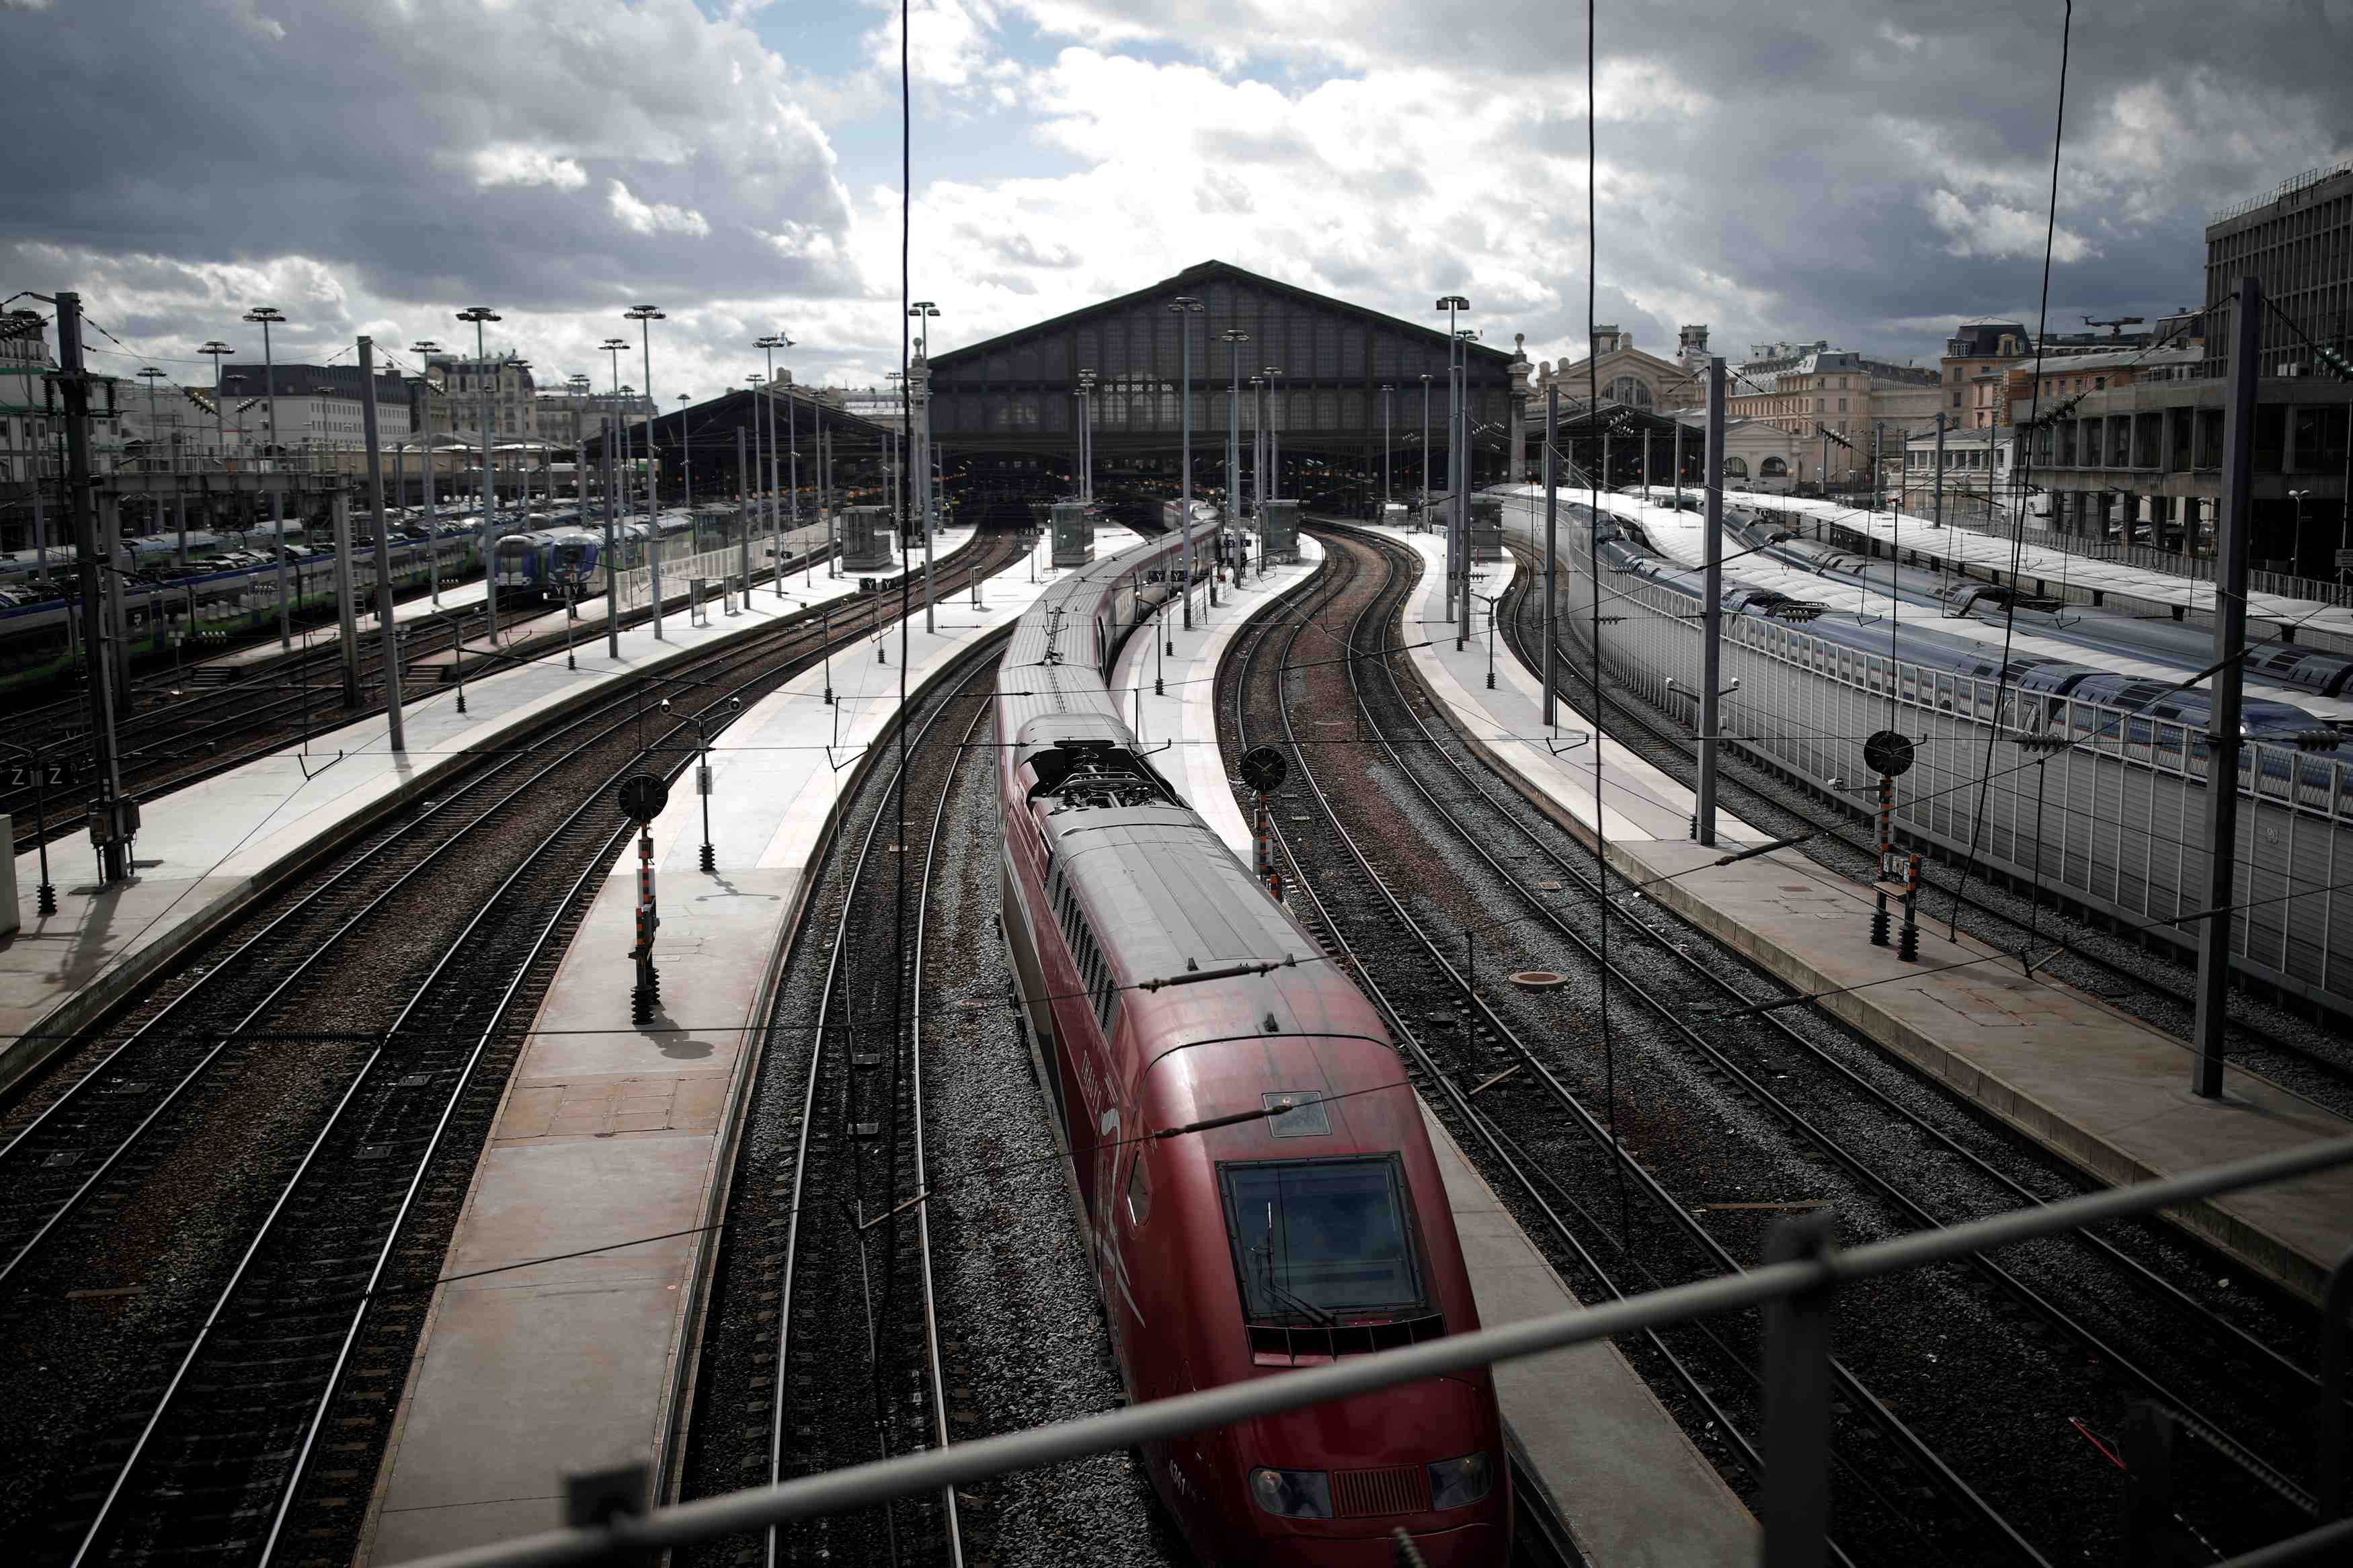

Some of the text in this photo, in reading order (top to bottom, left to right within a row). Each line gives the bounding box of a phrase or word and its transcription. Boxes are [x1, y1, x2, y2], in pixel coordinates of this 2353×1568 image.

[1156, 573, 1162, 581] Y
[1173, 573, 1180, 581] Y
[867, 581, 873, 589] Y
[885, 580, 891, 589] Y
[555, 585, 562, 594] Y
[573, 585, 579, 594] Y
[11, 769, 25, 786] Z
[49, 768, 63, 784] Z
